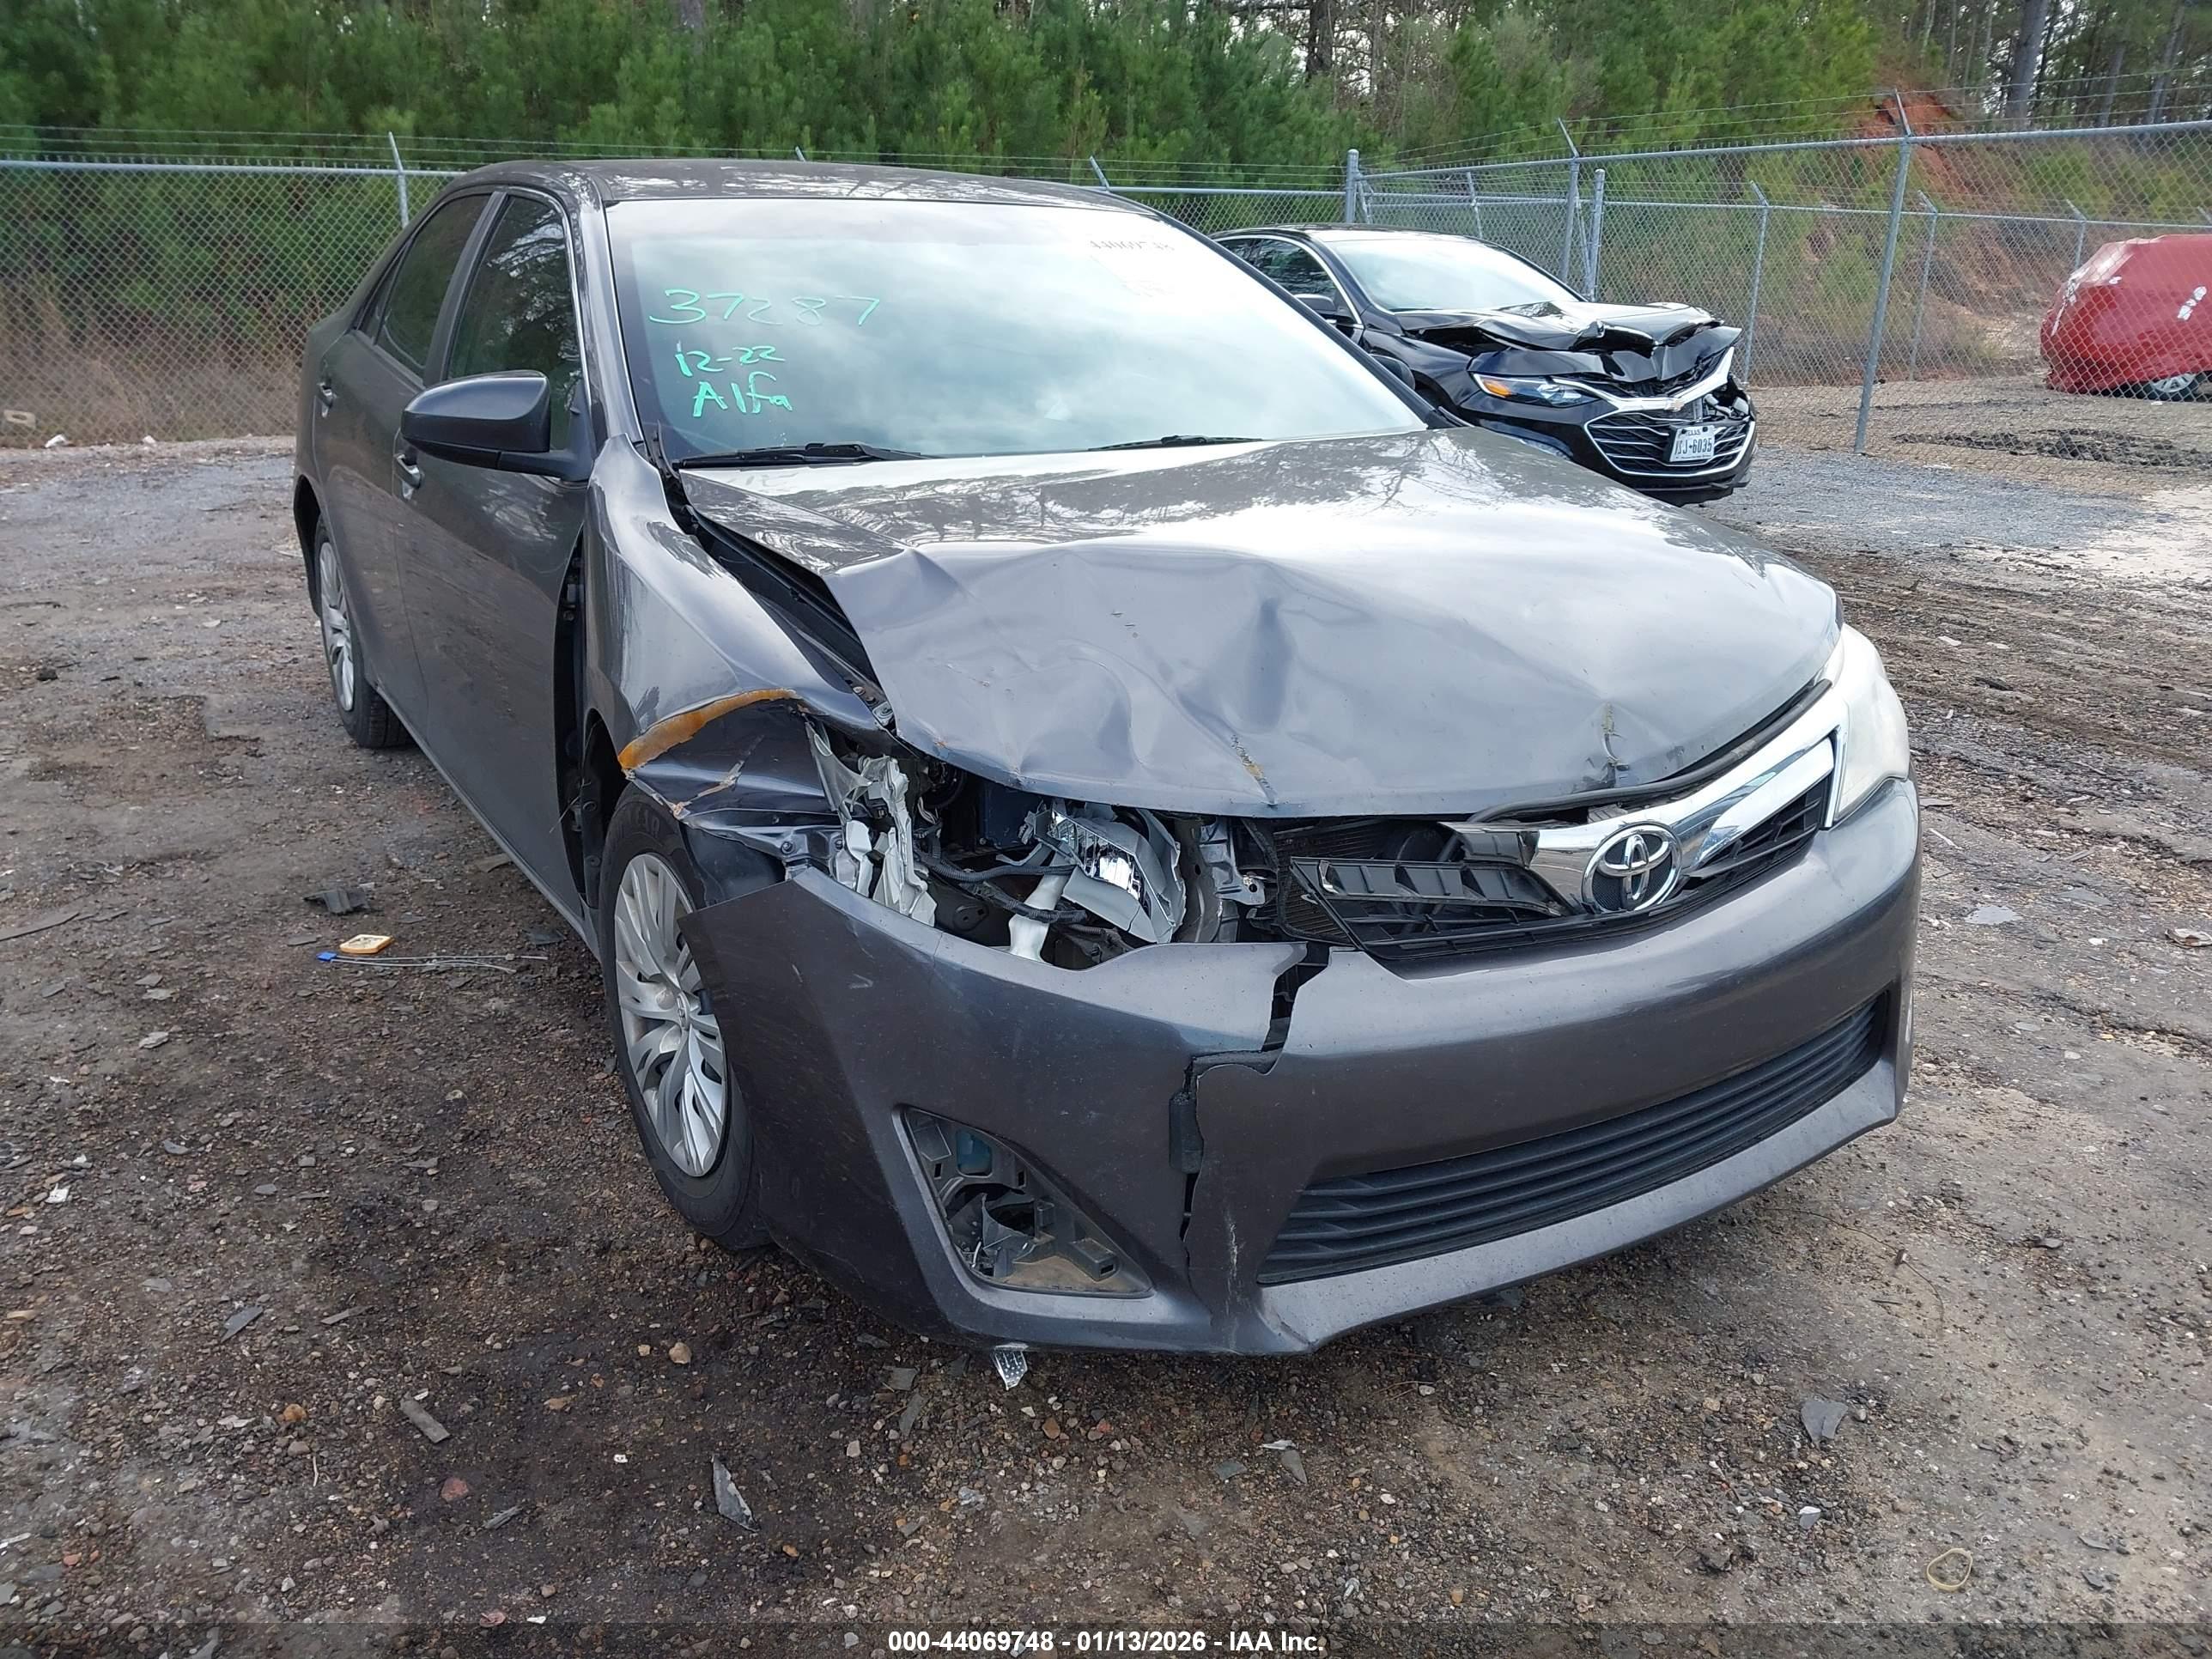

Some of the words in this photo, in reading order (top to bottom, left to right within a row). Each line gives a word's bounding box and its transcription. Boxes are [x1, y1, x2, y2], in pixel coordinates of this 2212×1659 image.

[649, 289, 880, 325] 37287
[675, 341, 786, 376] 12-22
[693, 372, 793, 416] Alfa
